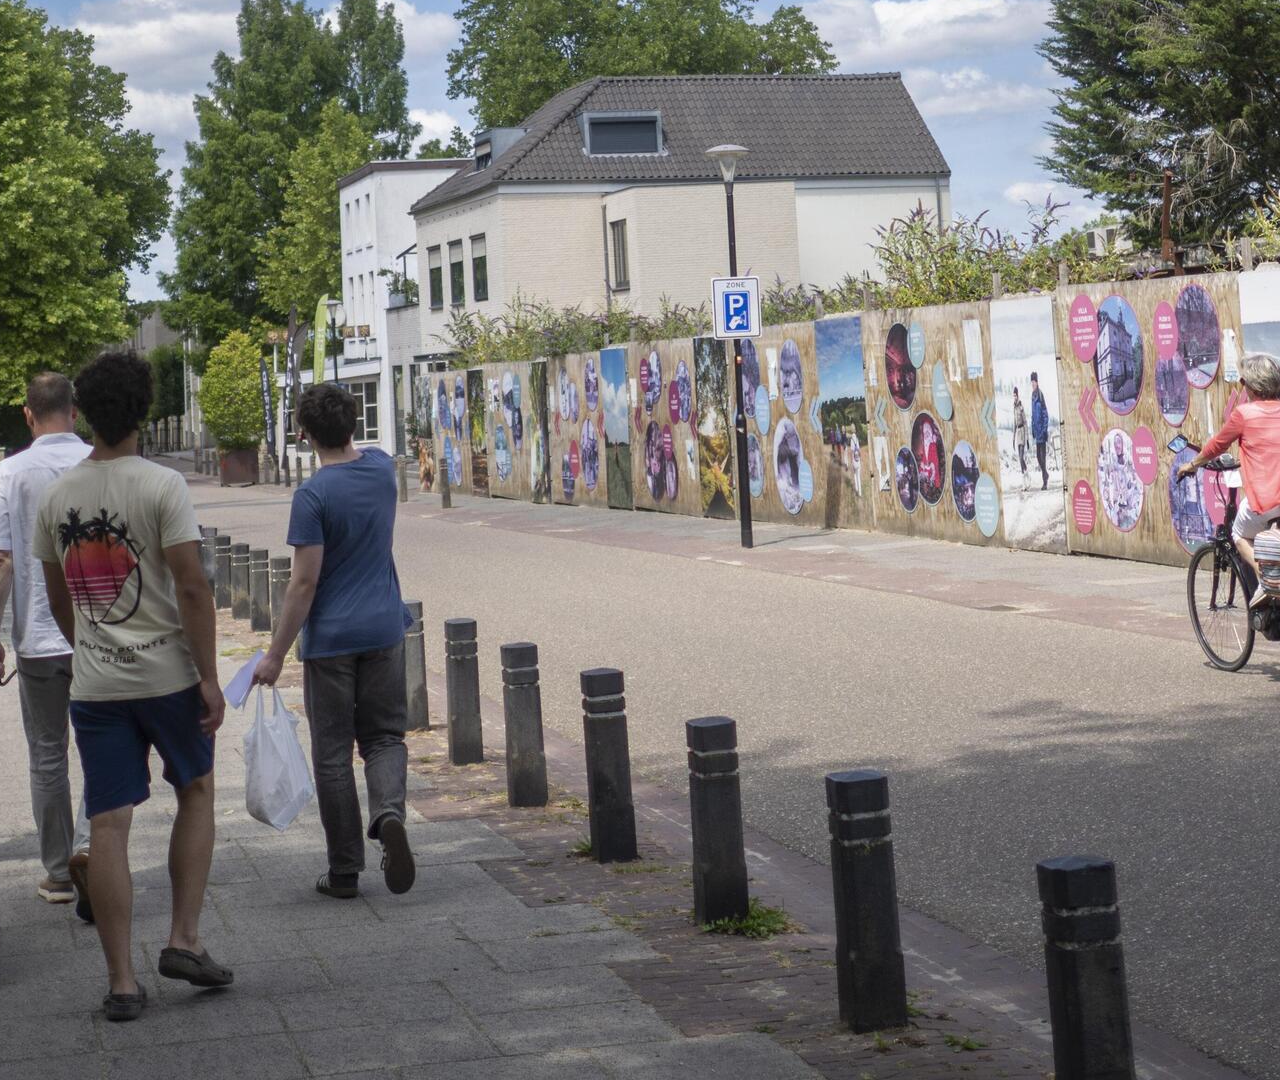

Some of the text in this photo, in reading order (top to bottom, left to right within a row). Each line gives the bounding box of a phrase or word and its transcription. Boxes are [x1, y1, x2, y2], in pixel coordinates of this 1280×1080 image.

[729, 295, 744, 315] P
[117, 639, 167, 653] POINTE
[113, 655, 137, 664] STAGE
